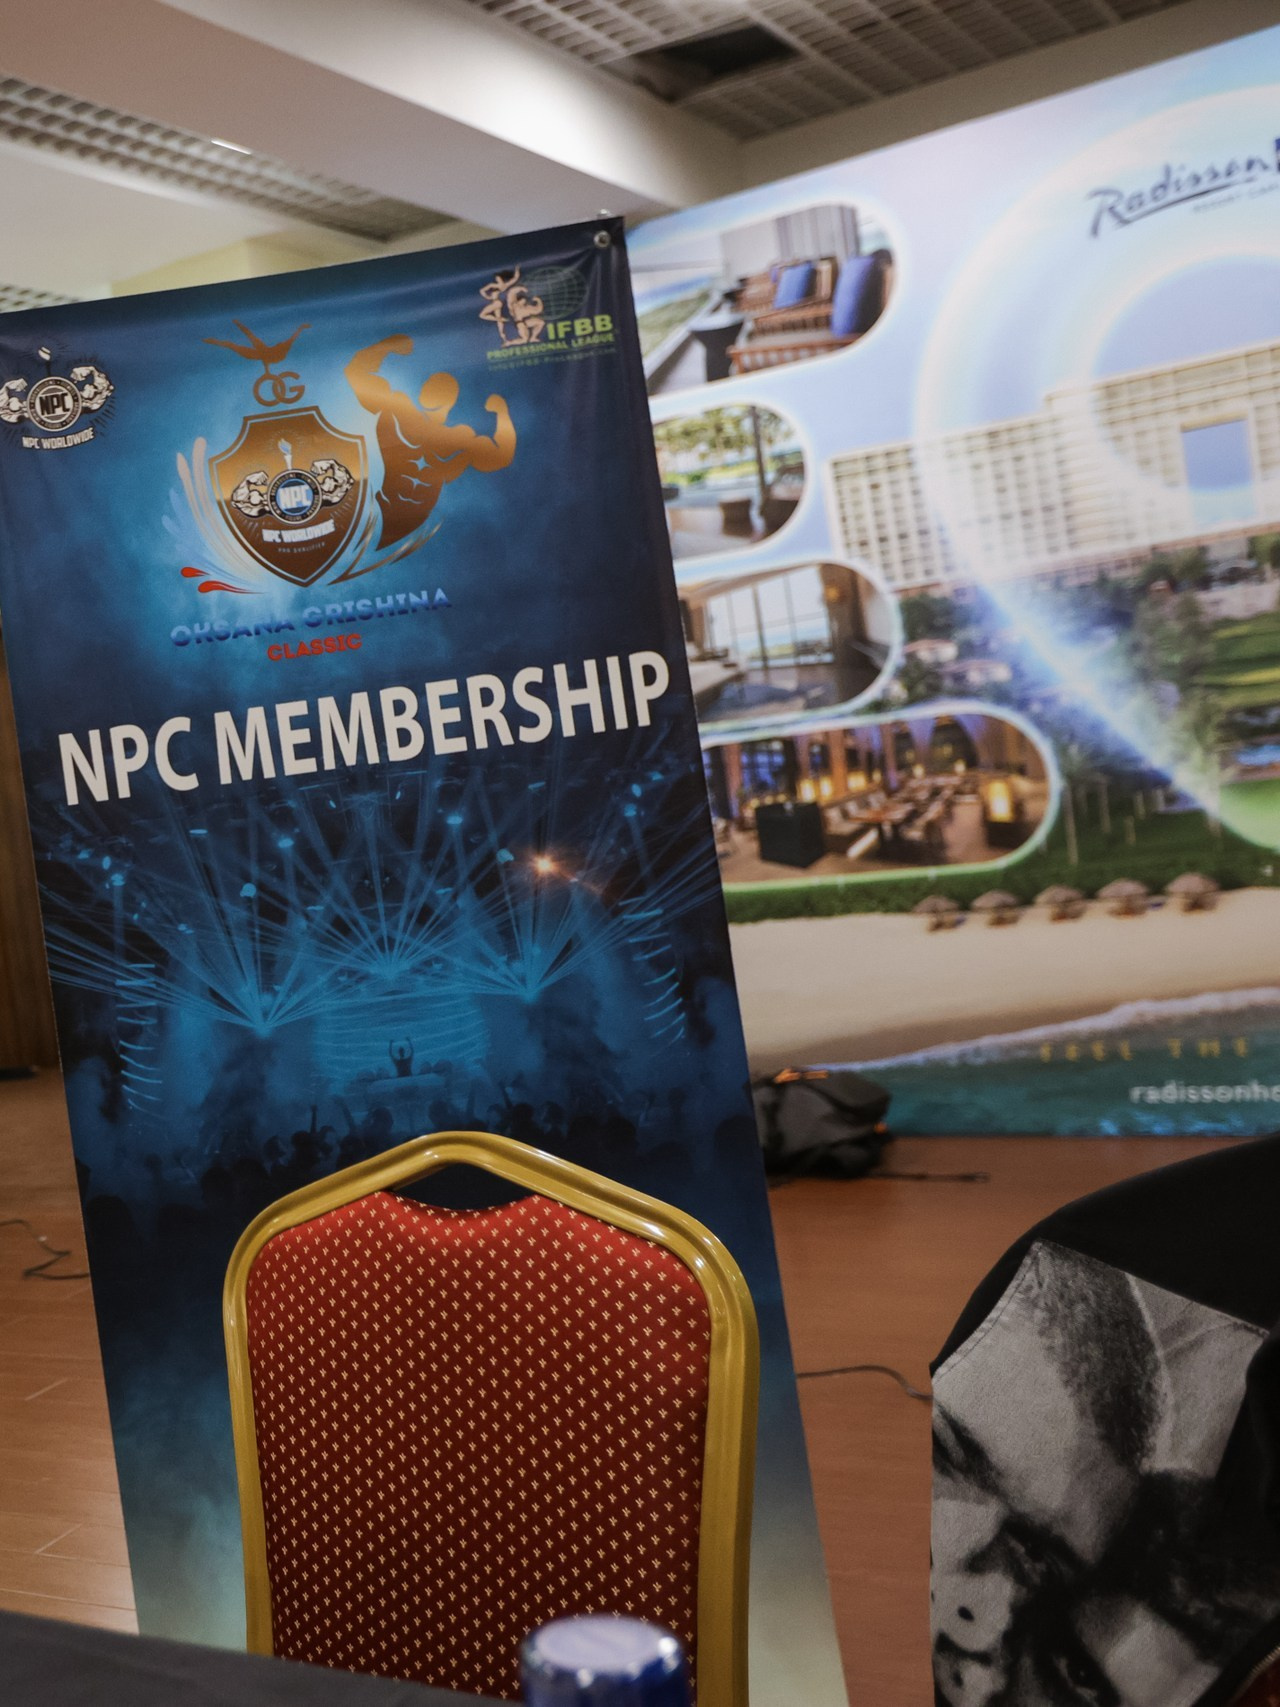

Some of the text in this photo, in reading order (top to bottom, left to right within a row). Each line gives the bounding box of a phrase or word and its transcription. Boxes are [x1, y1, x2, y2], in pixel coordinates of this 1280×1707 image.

[546, 314, 613, 340] IFBB
[486, 333, 616, 360] PROFESSIONAL LEAGUE
[39, 392, 71, 416] NPC
[22, 427, 95, 449] NPC WORLDWIDE
[279, 484, 311, 510] NPC
[262, 528, 281, 543] NPC
[170, 587, 453, 647] OKSANA GRISHINA
[266, 633, 363, 661] CLASSIC
[58, 650, 670, 806] NPC MEMBERSHIP
